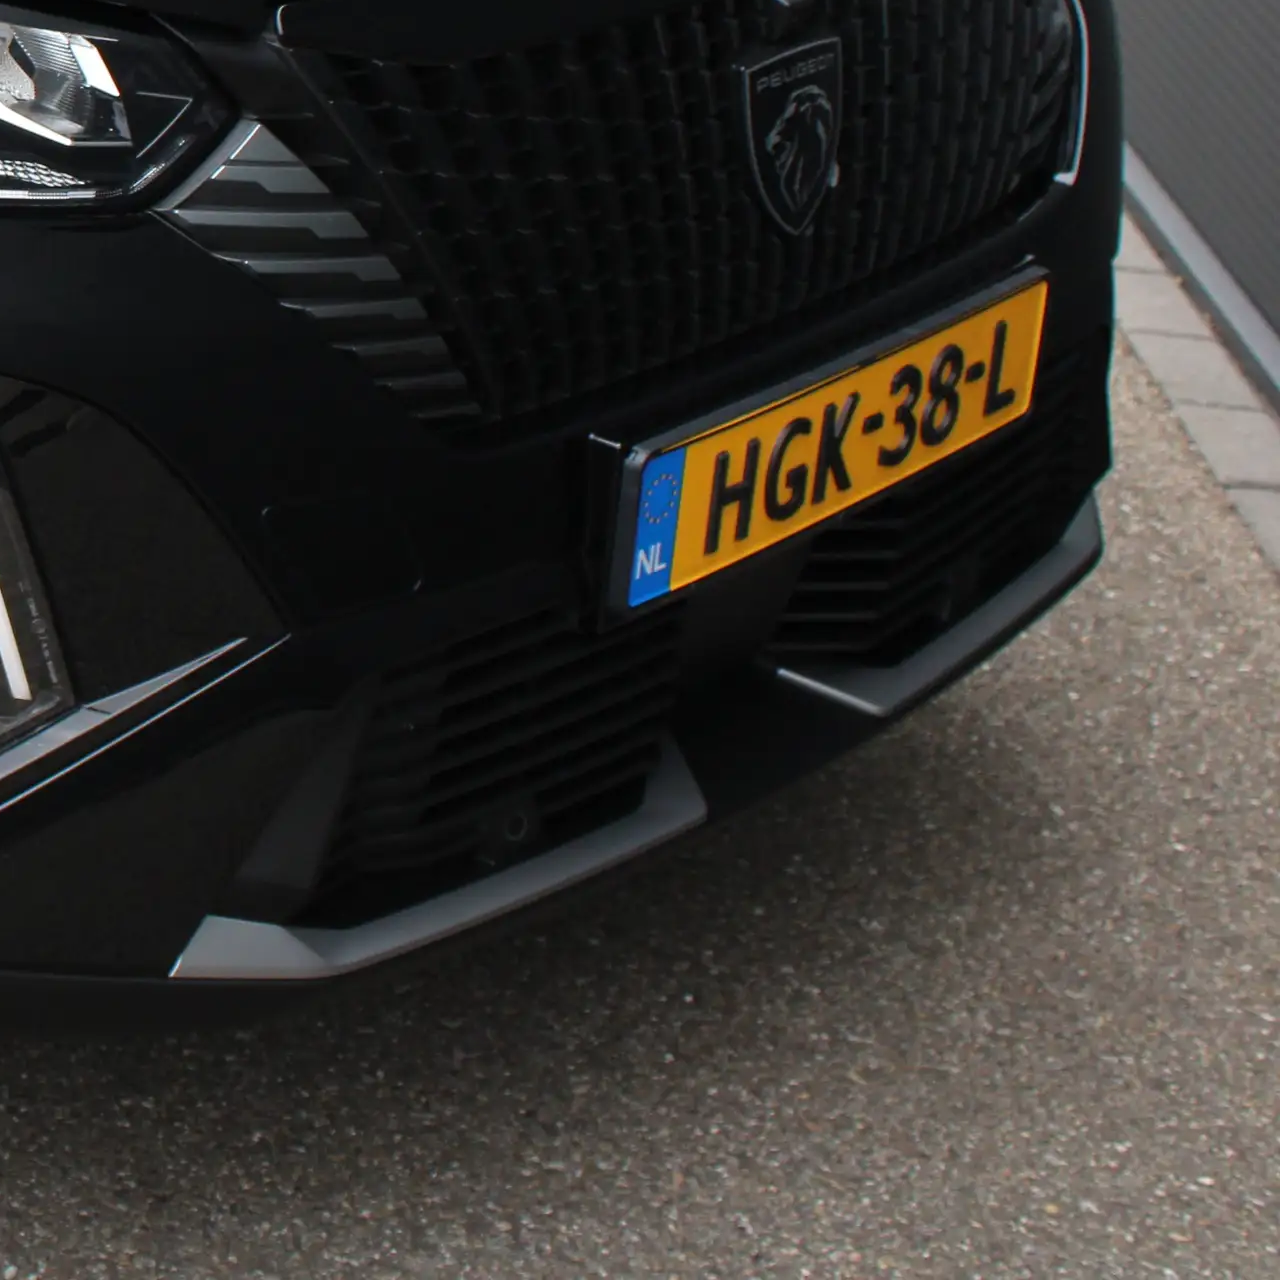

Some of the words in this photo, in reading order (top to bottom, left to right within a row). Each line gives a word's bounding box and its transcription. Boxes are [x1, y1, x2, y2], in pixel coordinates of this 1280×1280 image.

[755, 52, 835, 95] PEUGEOT
[703, 318, 1016, 557] HGK-38-L
[635, 542, 667, 581] NL
